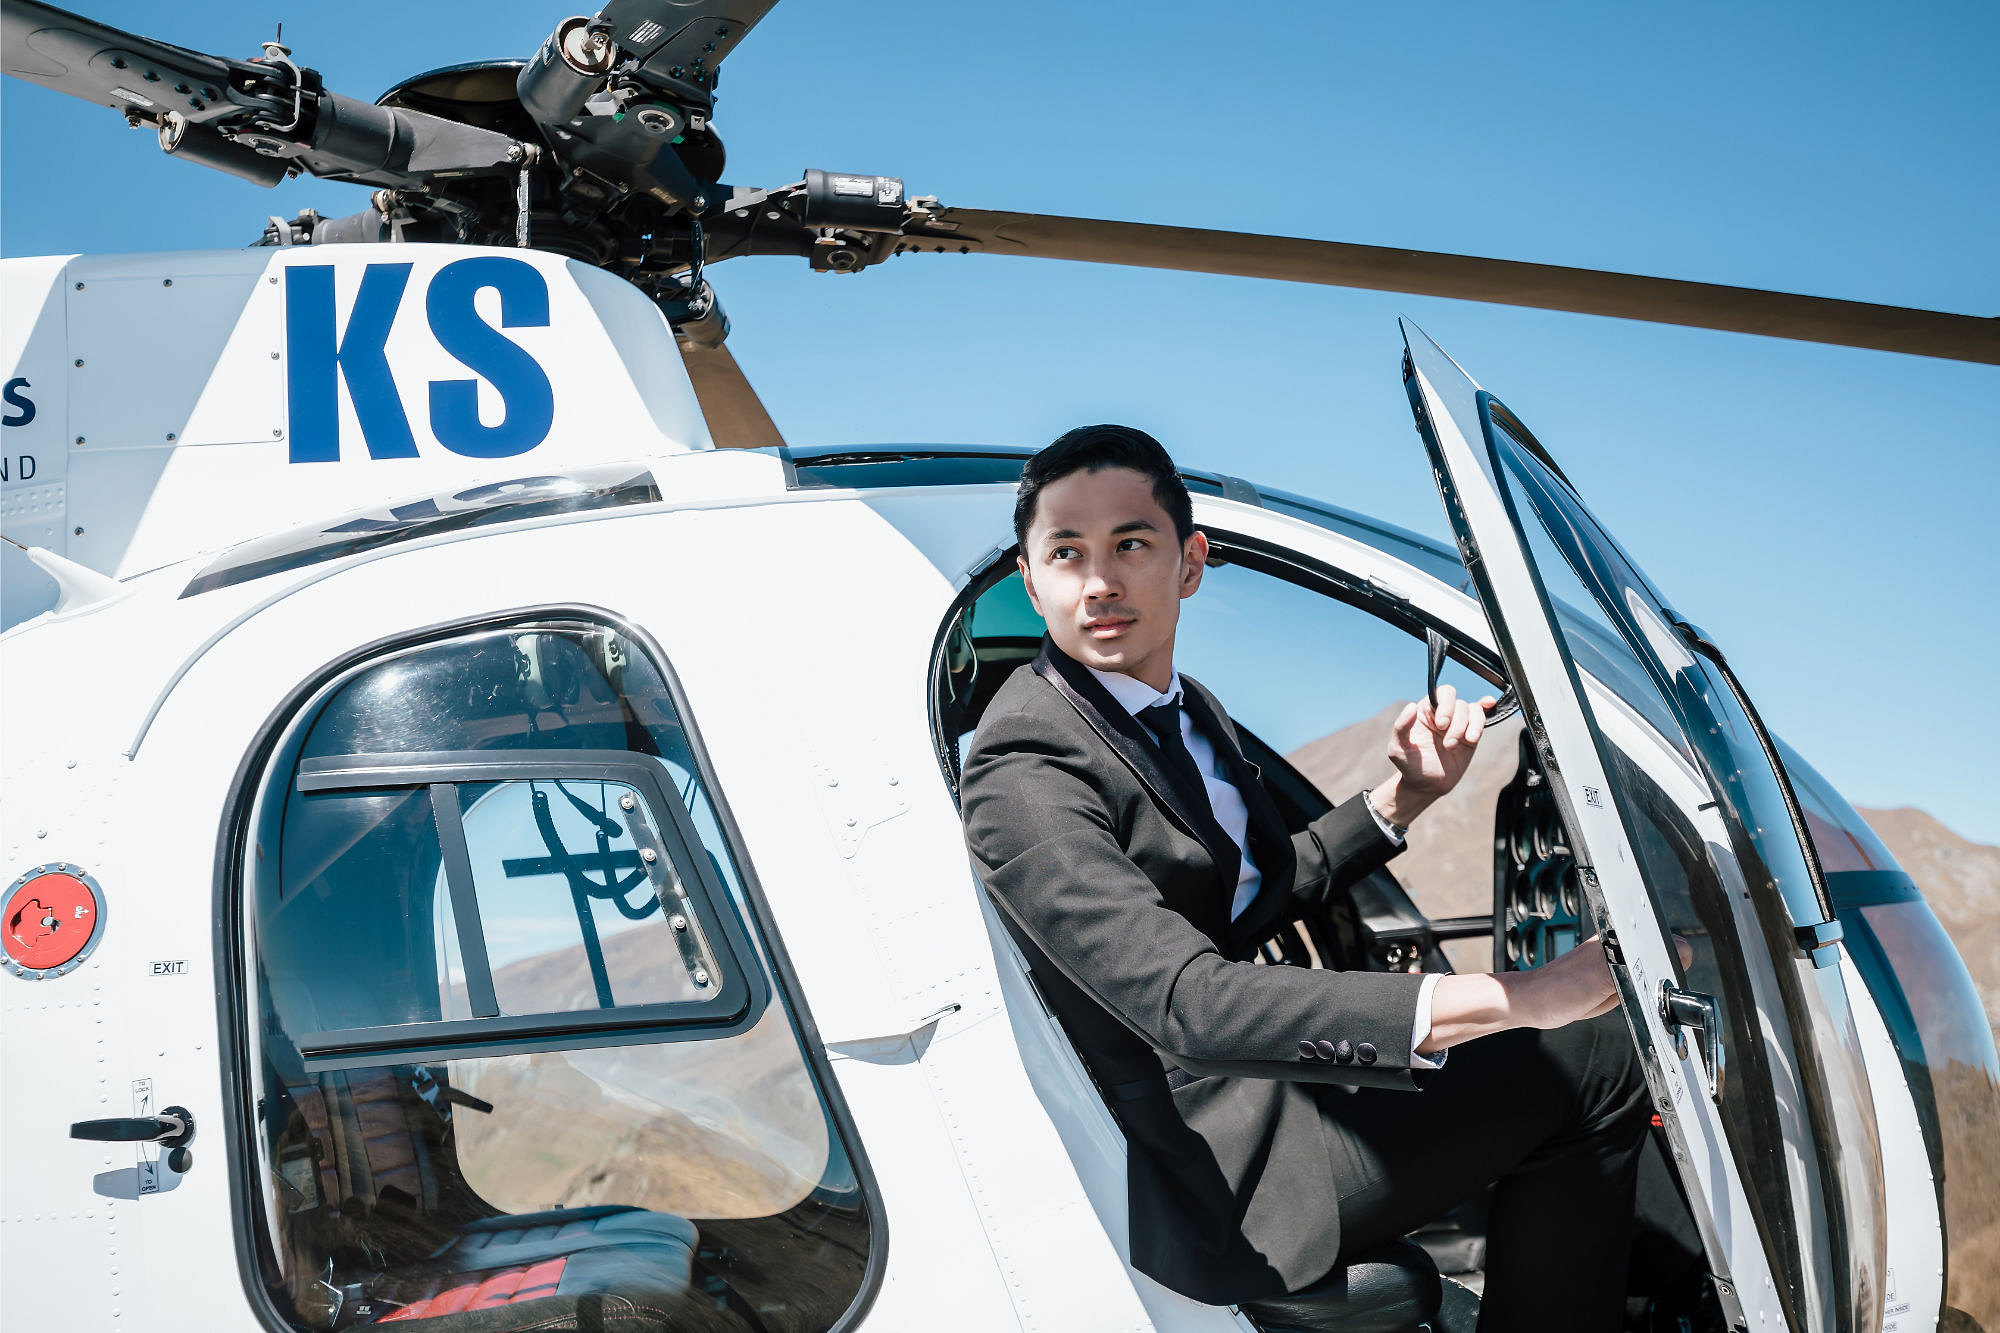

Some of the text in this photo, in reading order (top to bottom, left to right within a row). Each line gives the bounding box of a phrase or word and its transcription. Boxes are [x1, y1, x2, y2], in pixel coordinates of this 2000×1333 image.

[285, 256, 554, 464] KS
[2, 377, 36, 427] S
[1585, 788, 1600, 805] EXIT
[153, 961, 184, 974] EXIT
[135, 1086, 150, 1094] LOCK
[141, 1184, 157, 1192] OPEN
